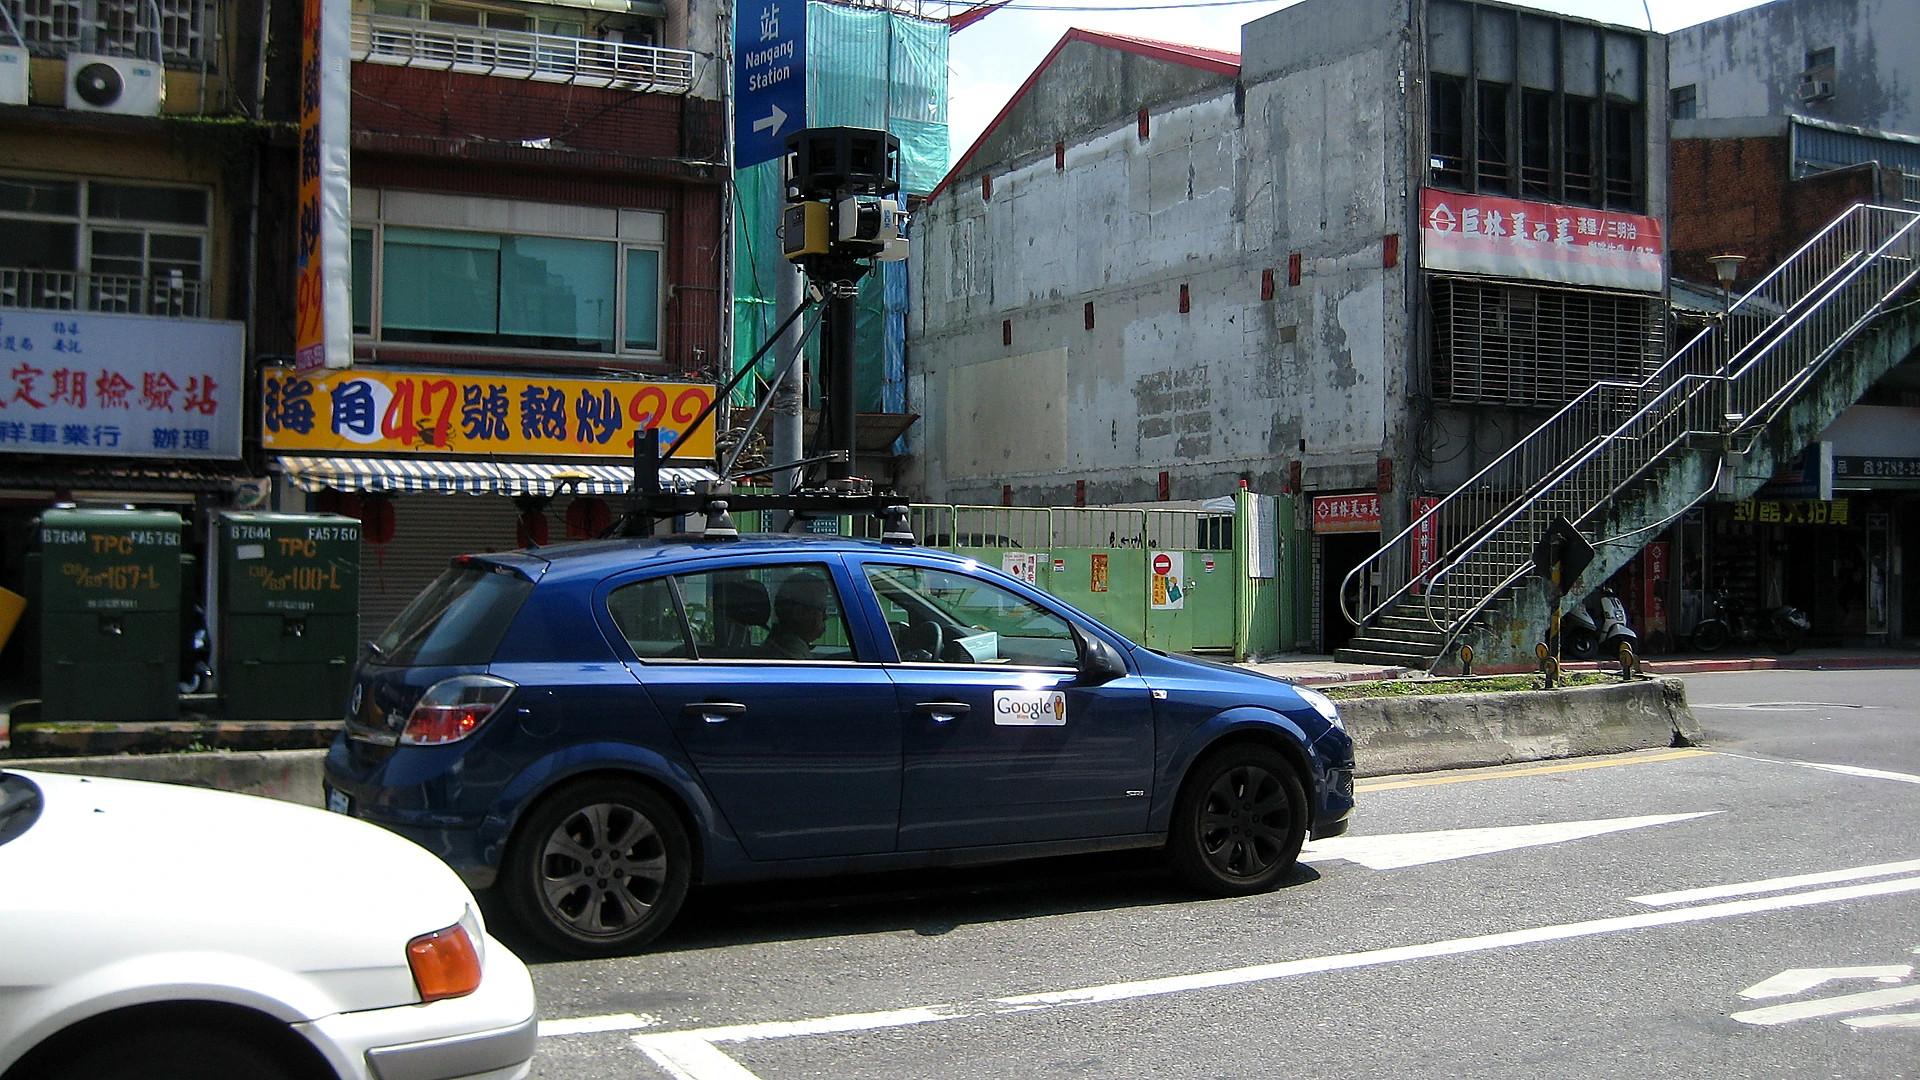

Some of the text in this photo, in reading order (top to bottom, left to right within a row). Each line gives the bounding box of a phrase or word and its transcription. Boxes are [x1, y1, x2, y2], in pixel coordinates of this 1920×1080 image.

[760, 3, 780, 42] 站
[745, 39, 794, 70] Nangang
[749, 66, 790, 92] Station
[1462, 207, 1581, 253] 巨林美而美
[0, 362, 219, 416] 定期檢驗站
[152, 427, 210, 450] 辦理
[1330, 498, 1380, 518] 巨林美而美
[91, 534, 134, 555] TPC
[130, 531, 181, 546] FA5750
[309, 527, 358, 541] FA5750
[278, 537, 317, 558] TPC
[997, 697, 1051, 719] Google
